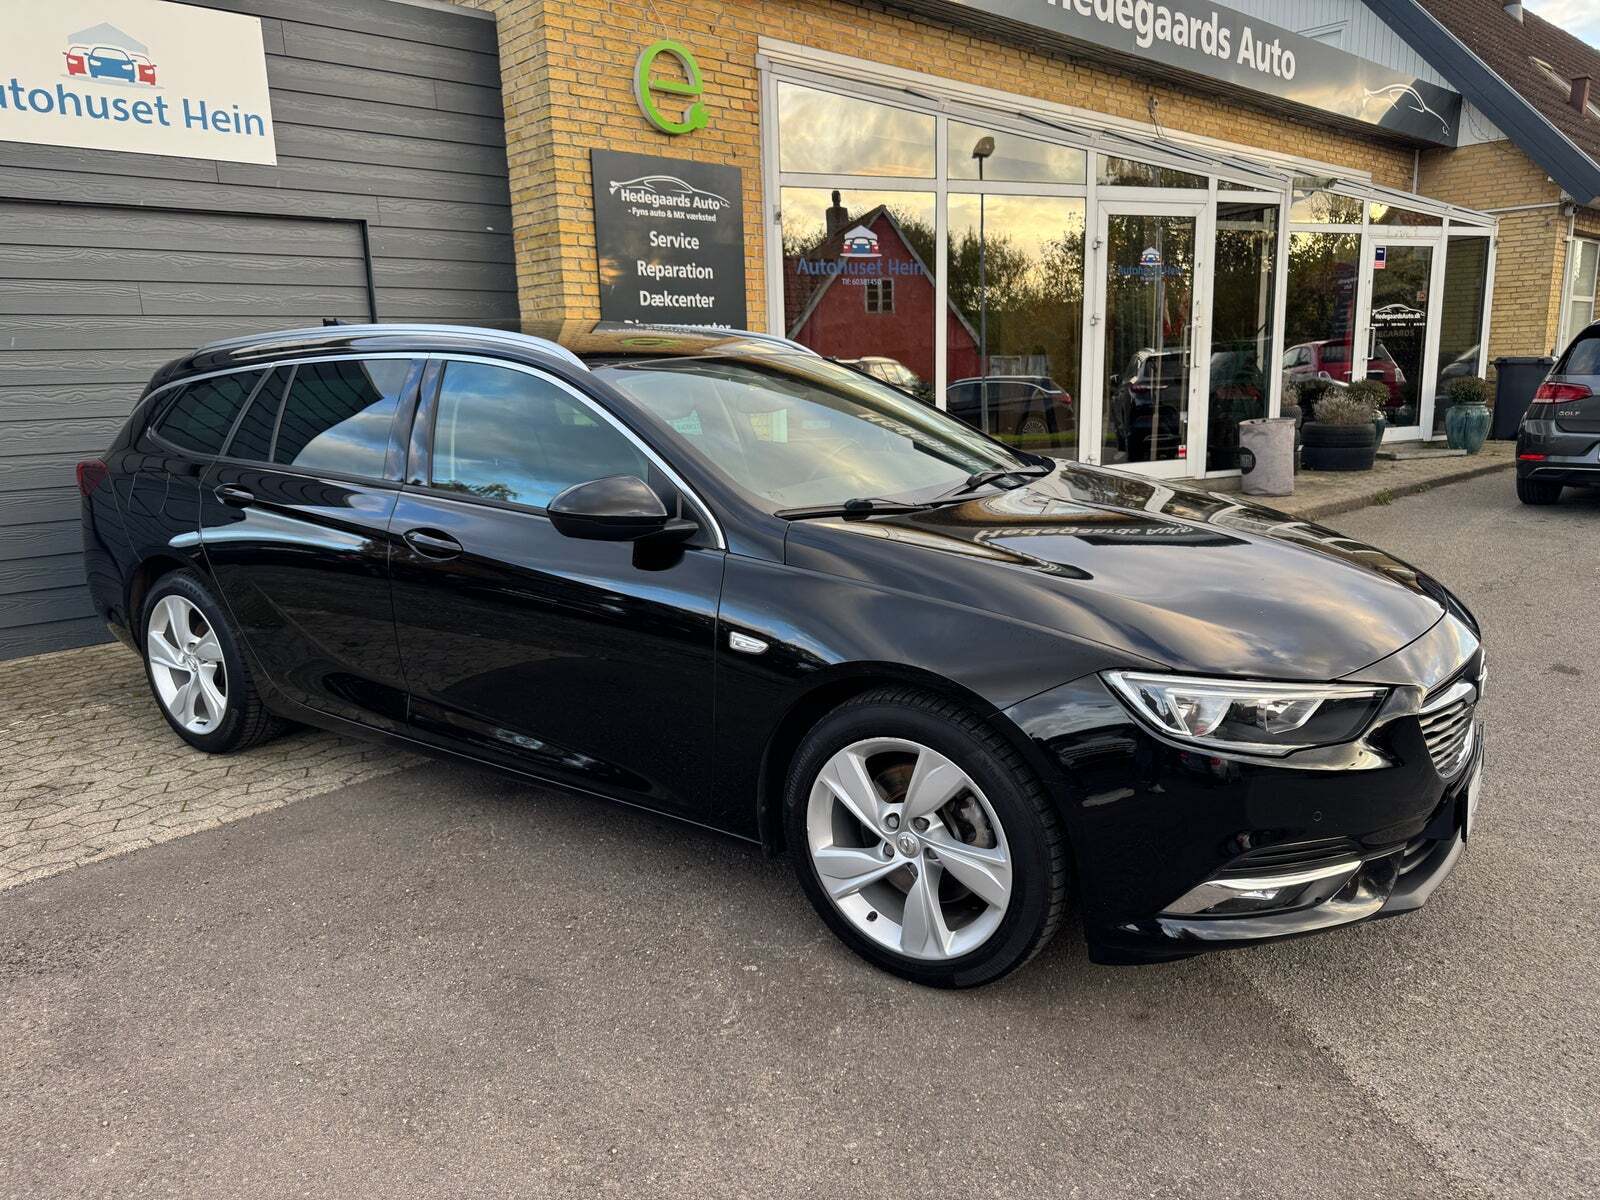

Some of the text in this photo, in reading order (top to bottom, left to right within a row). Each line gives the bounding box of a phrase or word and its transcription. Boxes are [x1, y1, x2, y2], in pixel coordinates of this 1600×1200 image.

[1047, 0, 1296, 80] edegaards Auto
[0, 78, 265, 136] tohuset Hein
[620, 188, 720, 210] Hedegaards Auto
[650, 208, 666, 218] auto
[667, 209, 673, 218] &
[674, 211, 685, 220] MX
[649, 231, 700, 249] Service
[637, 260, 714, 280] Reparation
[797, 256, 925, 275] Autohuset Hein
[639, 290, 715, 308] Dækcenter
